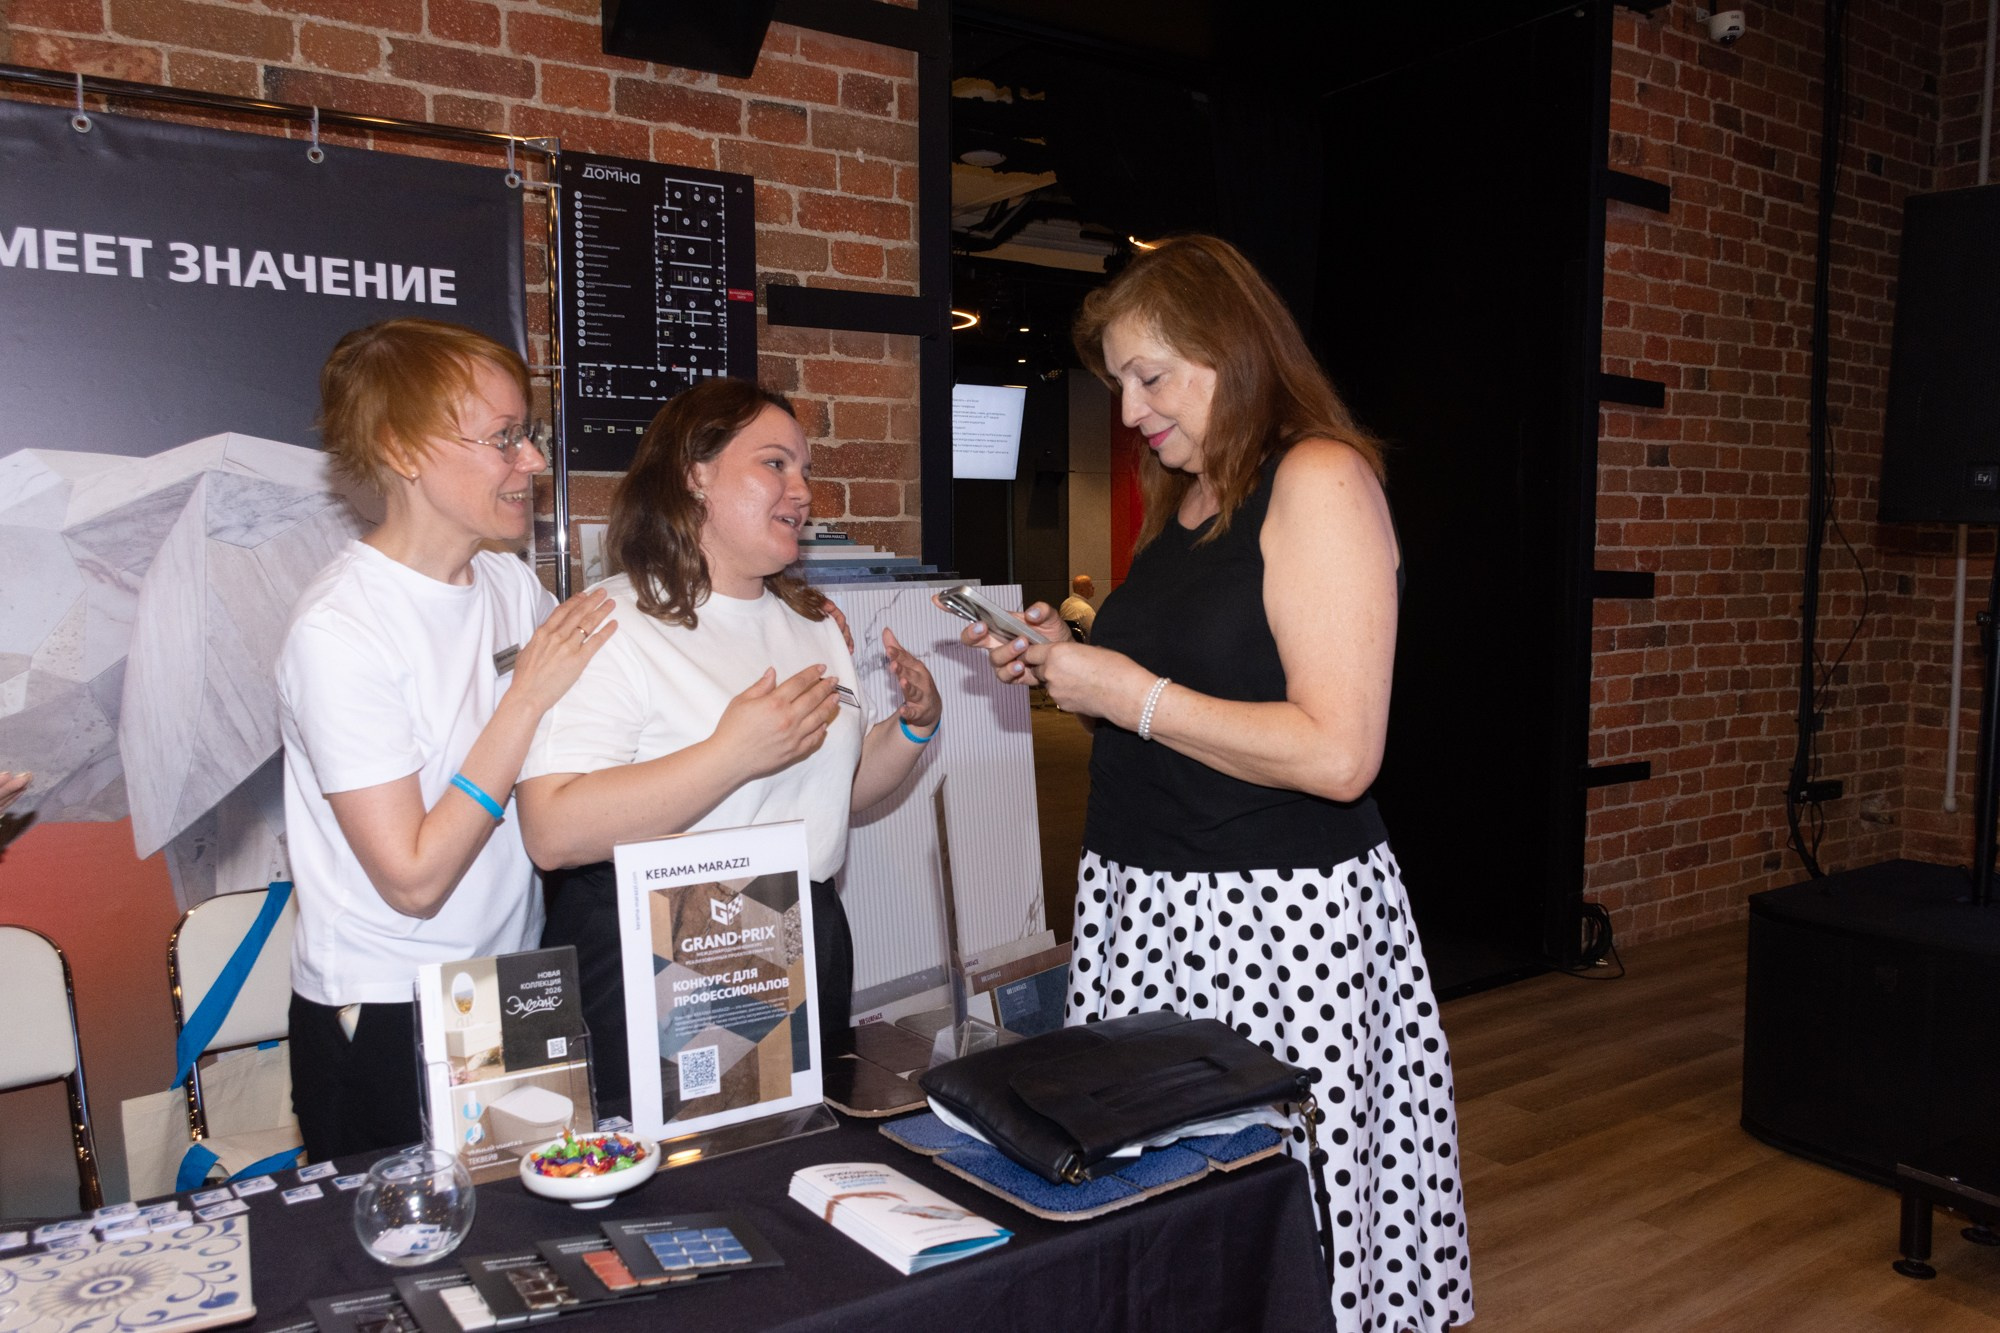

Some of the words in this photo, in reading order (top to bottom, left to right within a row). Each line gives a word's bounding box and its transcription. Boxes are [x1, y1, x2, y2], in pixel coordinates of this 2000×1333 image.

[0, 226, 153, 279] МЕЕТ
[168, 241, 458, 306] ЗНАЧЕНИЕ
[646, 864, 696, 881] KERAMA
[698, 857, 751, 873] MARAZZI
[520, 977, 562, 990] КОЛЛЕКЦИЯ
[537, 969, 561, 979] НОВАЯ
[672, 972, 731, 992] КОНКУРС
[732, 967, 759, 984] ДЛЯ
[674, 977, 790, 1007] ПРОФЕССИОНАЛОВ
